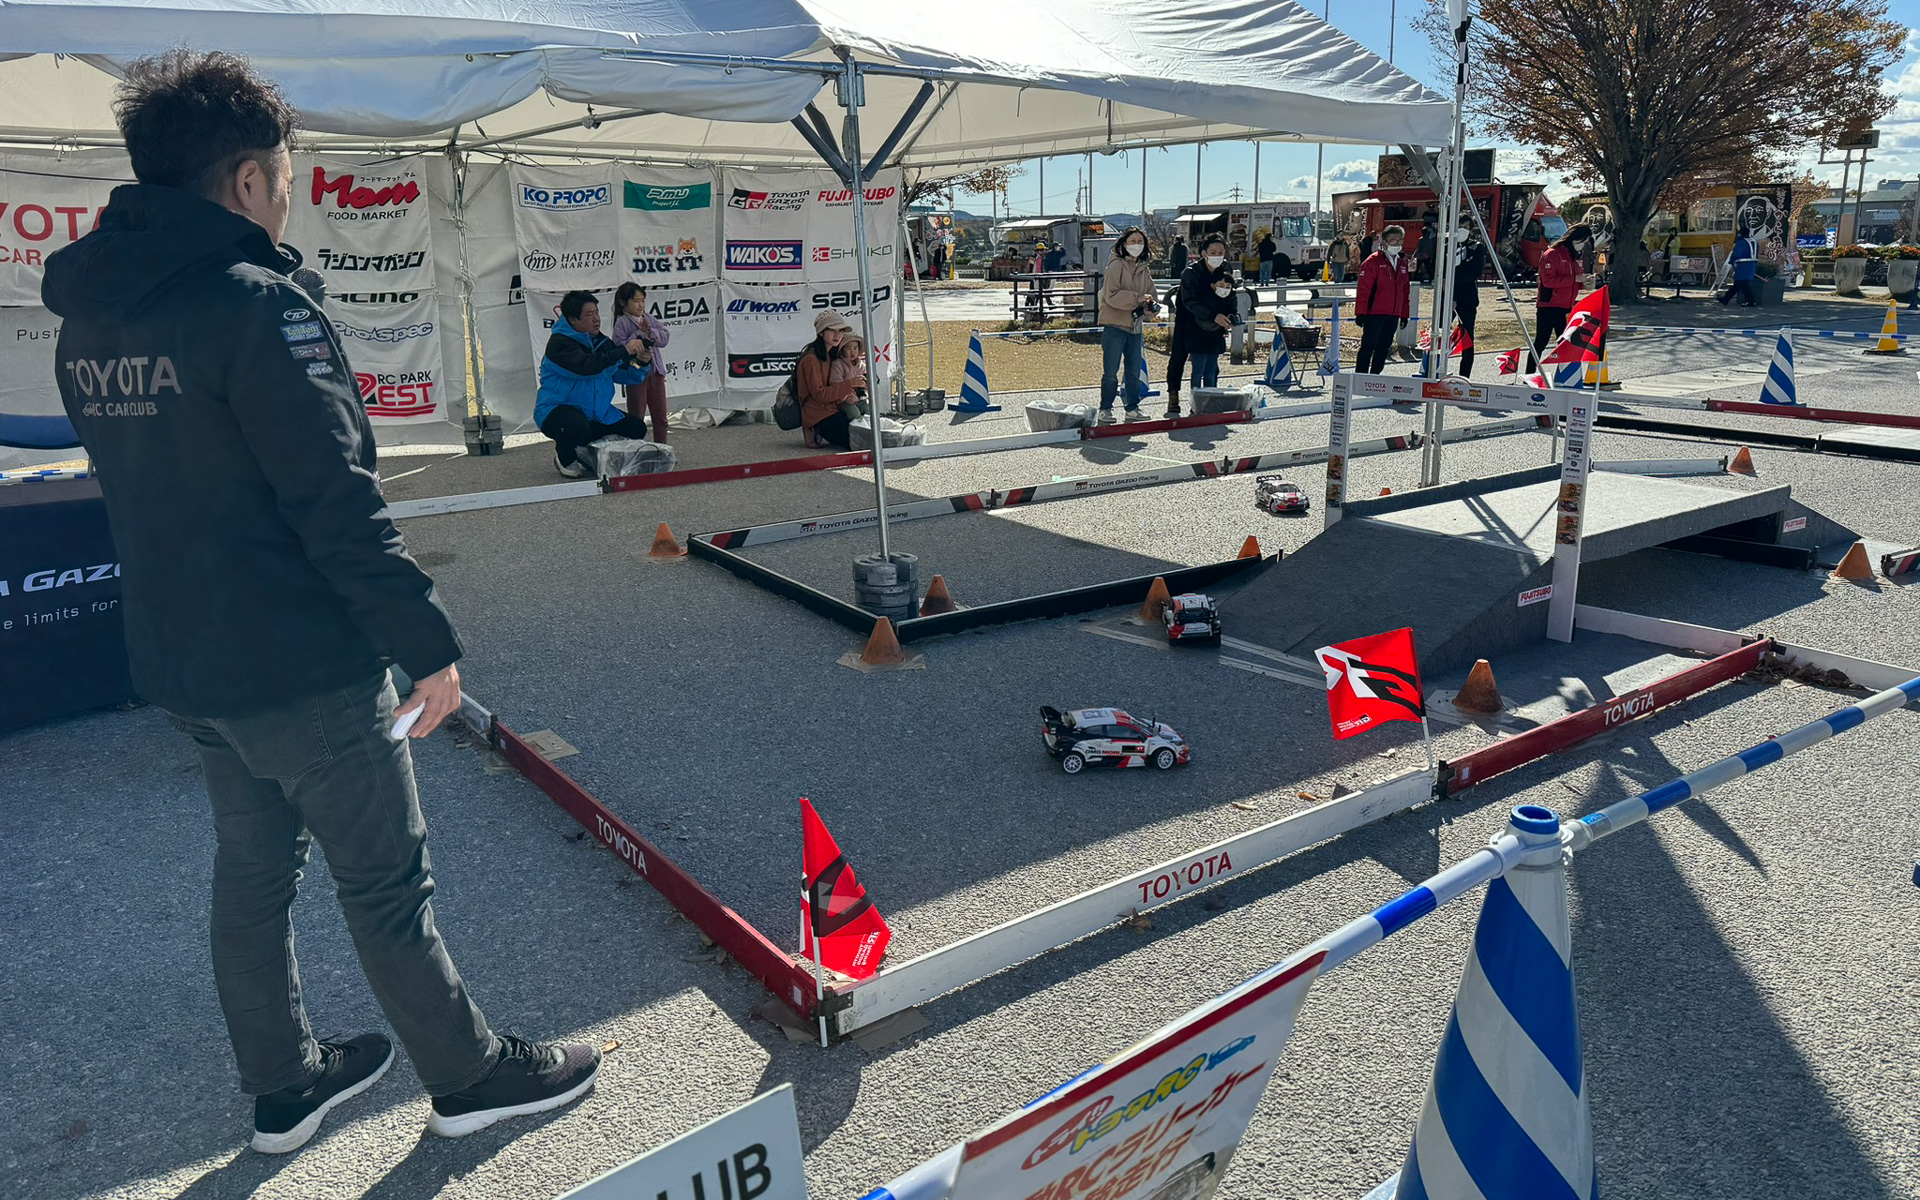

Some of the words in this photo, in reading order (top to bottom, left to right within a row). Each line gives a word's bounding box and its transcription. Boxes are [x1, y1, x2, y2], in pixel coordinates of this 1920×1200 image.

[523, 187, 549, 203] KO
[552, 186, 607, 204] PROPO
[770, 190, 810, 199] TOYOTA
[817, 186, 895, 202] FUJITUBO
[327, 211, 358, 220] FOOD
[361, 208, 408, 221] MARKET
[318, 249, 426, 271] ラジコンマガジン
[561, 250, 616, 262] HATTORI
[831, 245, 893, 260] SHIKO
[560, 260, 613, 269] MARKING
[632, 258, 672, 273] DIG
[649, 297, 710, 320] AEDA
[66, 356, 182, 397] TOYOTA
[377, 374, 396, 385] RC
[400, 371, 432, 384] PARK
[1089, 481, 1115, 489] TOYOTA
[818, 521, 851, 530] TOYOTA
[24, 607, 79, 626] limits
[92, 600, 118, 612] for
[1604, 692, 1655, 726] TOYOTA
[596, 813, 647, 875] TOYOTA
[1138, 851, 1232, 903] TOYOTA
[657, 1143, 772, 1200] UB
